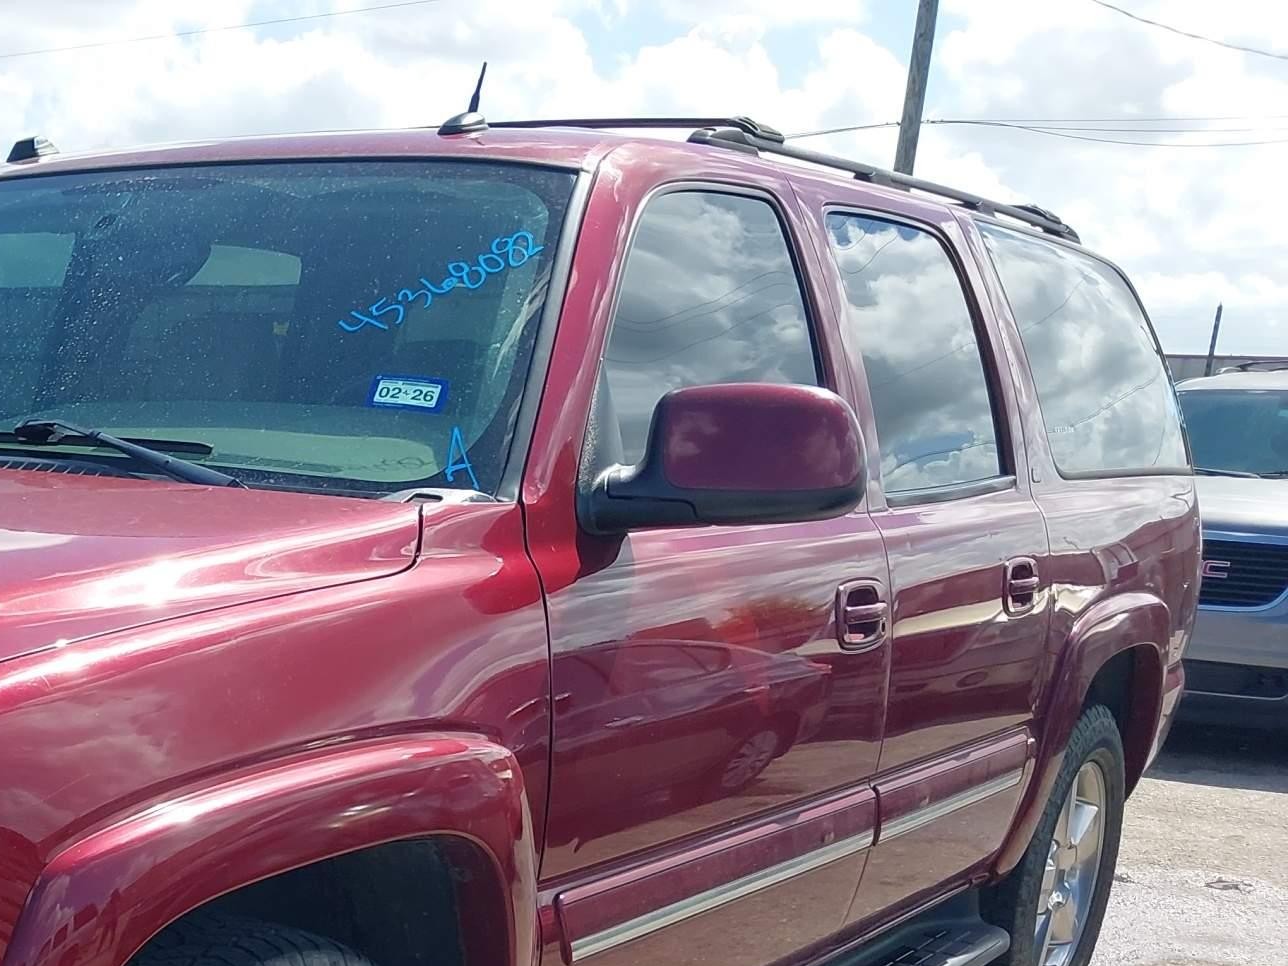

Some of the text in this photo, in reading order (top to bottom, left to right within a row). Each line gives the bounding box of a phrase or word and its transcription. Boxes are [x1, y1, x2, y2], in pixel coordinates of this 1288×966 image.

[338, 229, 544, 332] 45368082
[378, 386, 436, 403] 02 26
[445, 426, 480, 490] A
